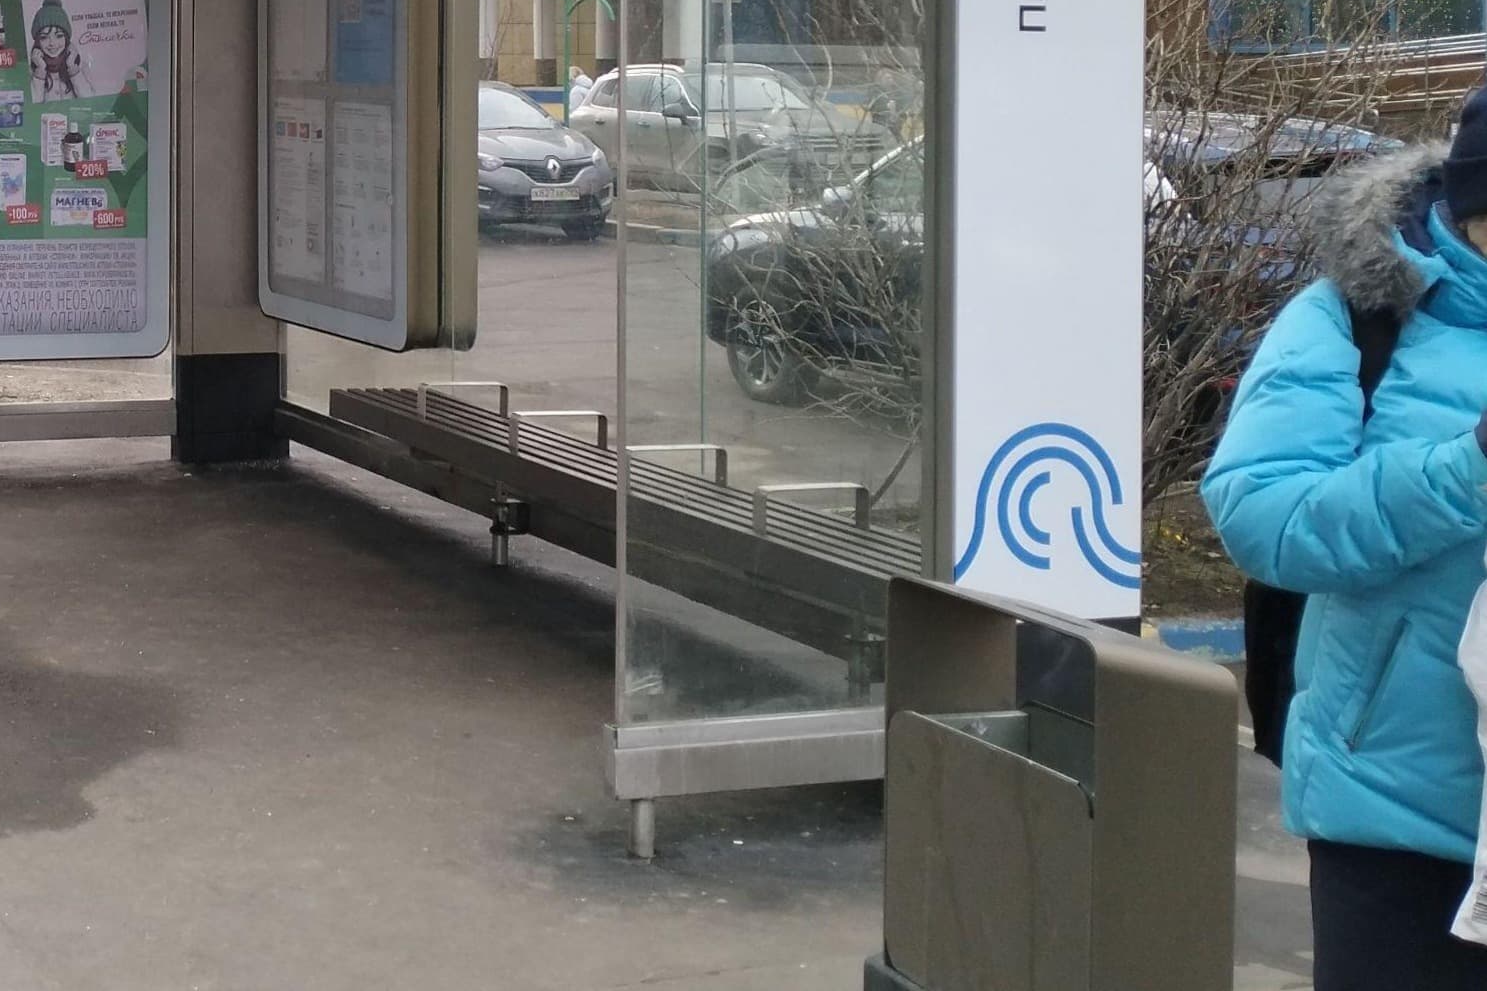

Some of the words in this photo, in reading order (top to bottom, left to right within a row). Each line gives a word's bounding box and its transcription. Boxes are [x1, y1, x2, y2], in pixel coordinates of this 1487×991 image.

[77, 163, 104, 177] -20%
[57, 289, 137, 310] НЕОБХОДИМО
[50, 310, 138, 331] СПЕЦИАЛИСТА
